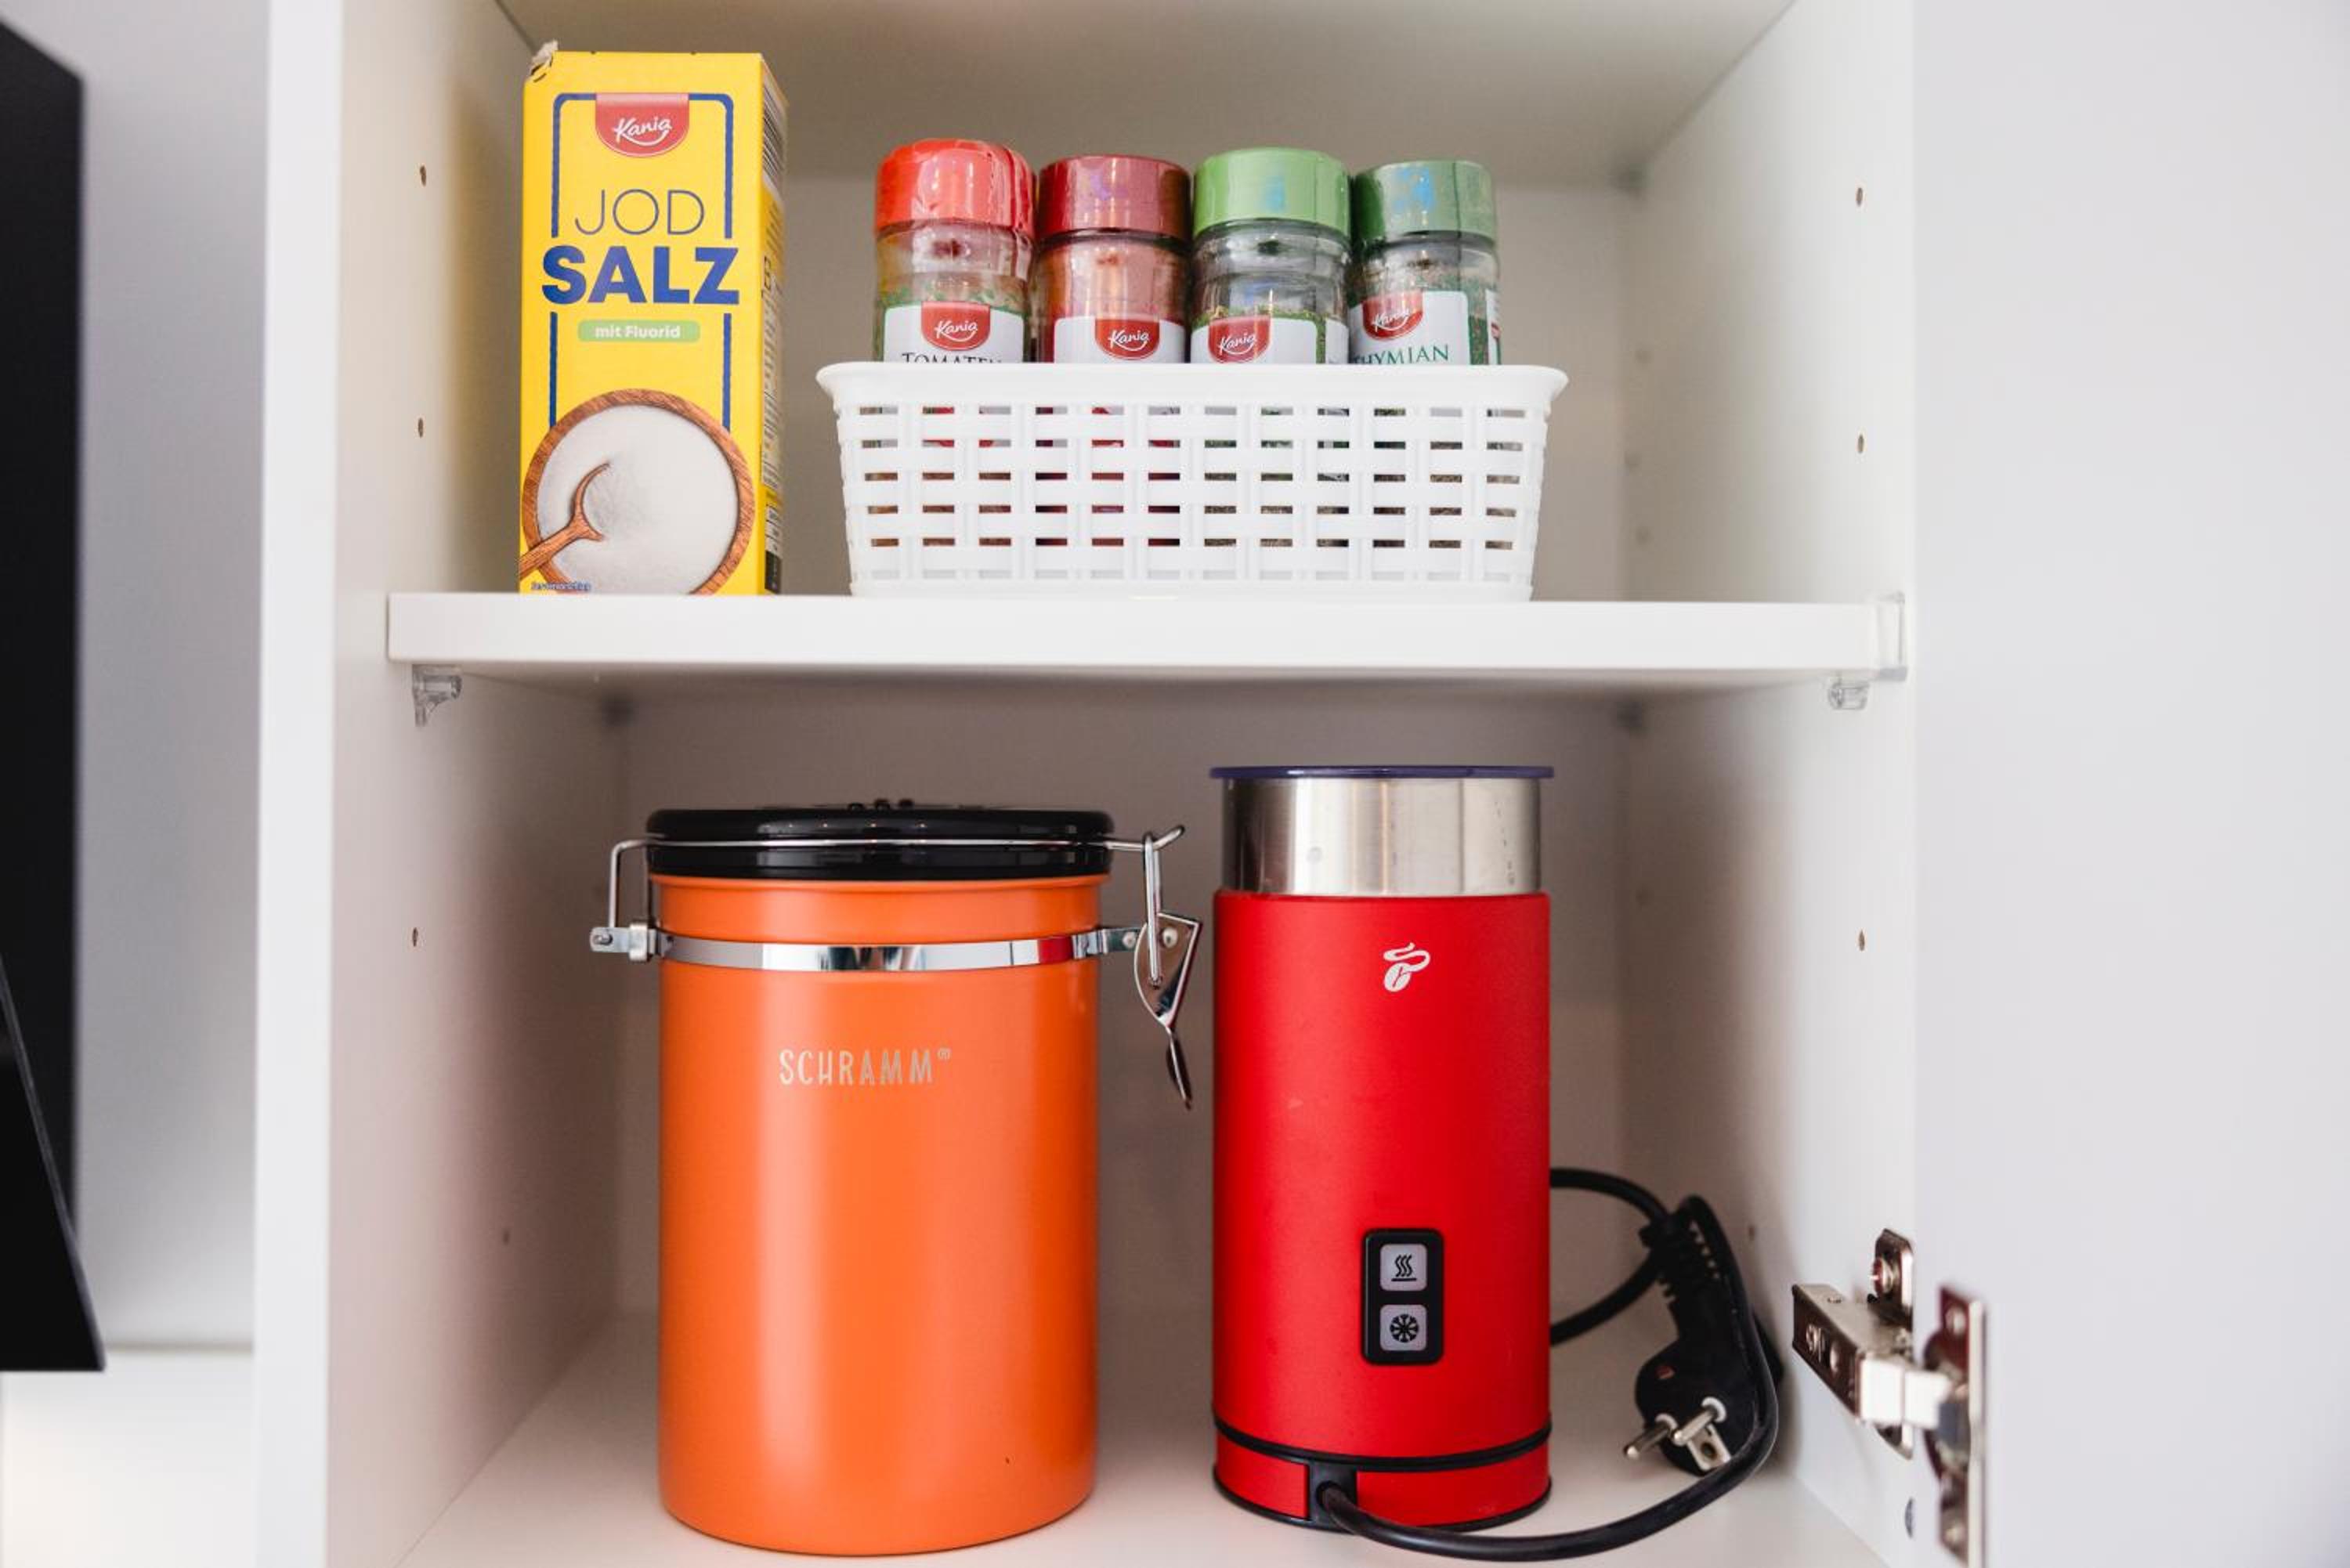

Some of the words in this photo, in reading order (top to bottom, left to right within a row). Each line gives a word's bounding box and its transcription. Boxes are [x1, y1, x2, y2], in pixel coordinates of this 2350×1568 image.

[613, 116, 672, 146] Kania
[575, 189, 704, 235] JOD
[541, 245, 739, 305] SALZ
[595, 325, 621, 338] mit
[626, 325, 681, 338] Fluorid
[935, 319, 978, 342] Kania
[1108, 329, 1149, 352] Kania
[1217, 332, 1256, 355] Kania
